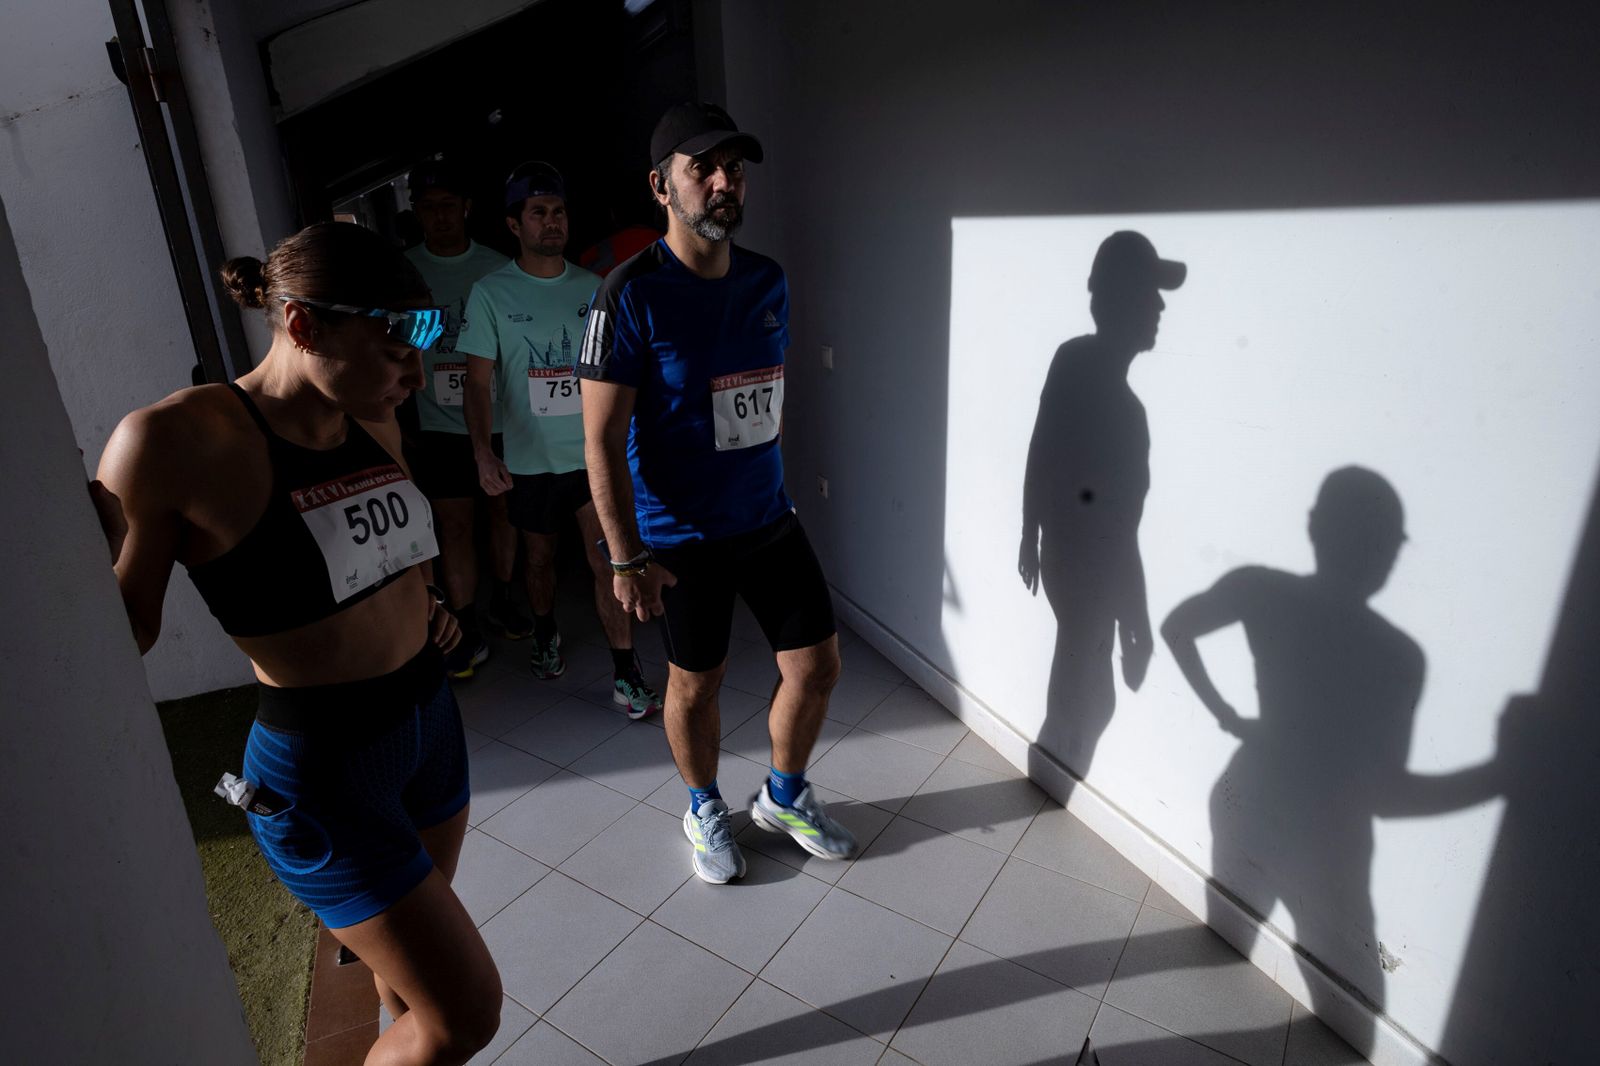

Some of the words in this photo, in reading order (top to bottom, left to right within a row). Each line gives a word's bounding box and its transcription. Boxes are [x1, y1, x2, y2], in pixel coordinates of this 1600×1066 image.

[546, 379, 581, 398] 751
[734, 388, 774, 419] 617
[344, 491, 409, 545] 500
